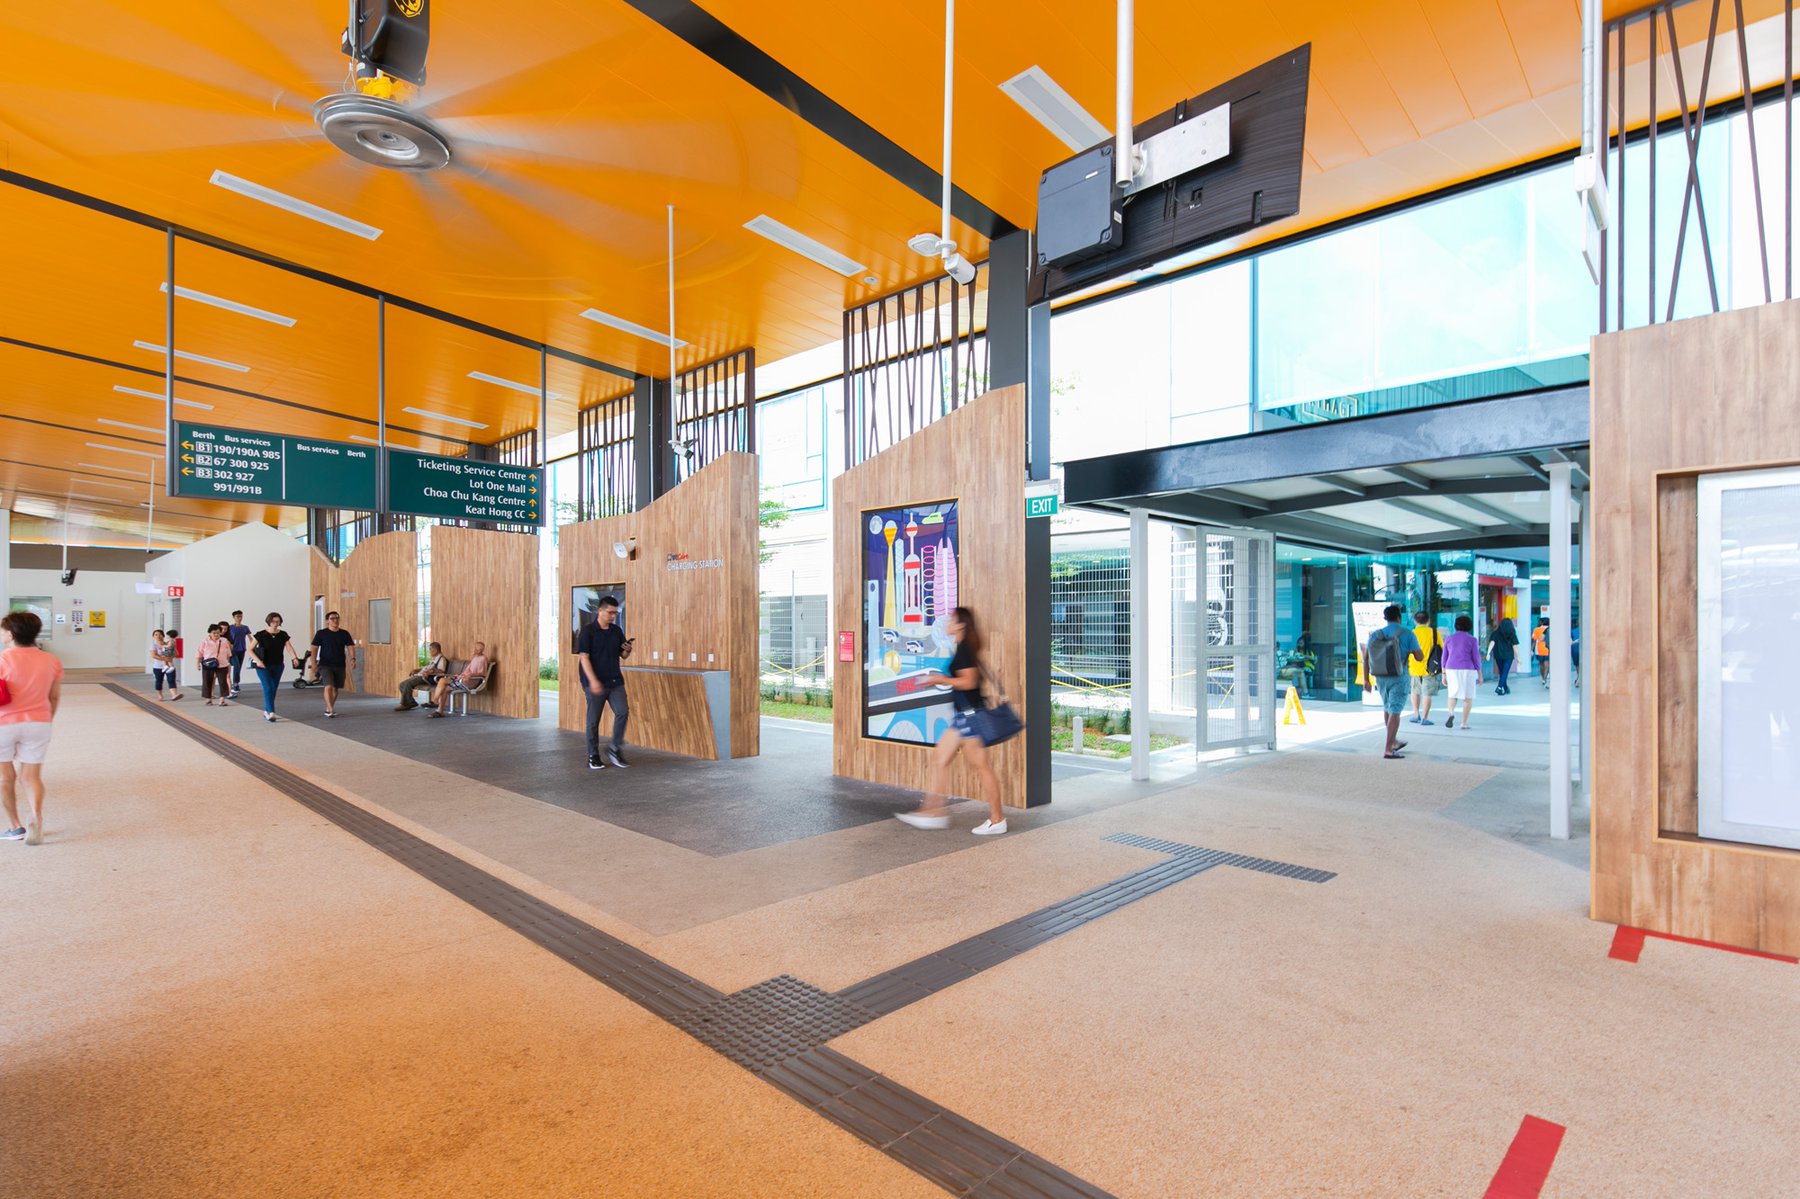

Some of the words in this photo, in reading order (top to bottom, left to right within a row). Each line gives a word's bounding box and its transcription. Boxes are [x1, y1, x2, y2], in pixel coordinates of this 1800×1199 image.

[192, 430, 215, 440] Berth
[224, 434, 239, 442] Bus
[240, 437, 271, 447] services
[197, 442, 212, 452] B1
[214, 444, 260, 458] 190/190A
[262, 450, 280, 460] 985
[297, 443, 310, 452] Bus
[312, 446, 339, 455] services
[347, 449, 366, 458] Berth
[197, 455, 212, 465] B2
[214, 457, 227, 466] 67
[229, 459, 248, 469] 300
[250, 462, 269, 471] 925
[417, 459, 461, 475] Ticketing
[463, 464, 496, 477] Service
[498, 469, 527, 481] Centre
[197, 467, 212, 477] B3
[214, 470, 233, 479] 302
[235, 472, 254, 481] 927
[213, 482, 262, 494] 991/991B
[469, 479, 484, 489] Lot
[486, 481, 505, 491] One
[507, 483, 526, 493] Mall
[423, 487, 448, 498] Choa
[451, 490, 469, 500] Chu
[472, 492, 496, 505] Kang
[497, 495, 526, 506] Centre
[465, 505, 486, 515] Keat
[488, 507, 513, 519] Hong
[514, 509, 526, 519] CC
[1031, 497, 1053, 514] EXIT
[667, 560, 697, 571] CHARGING
[699, 559, 723, 569] STATION
